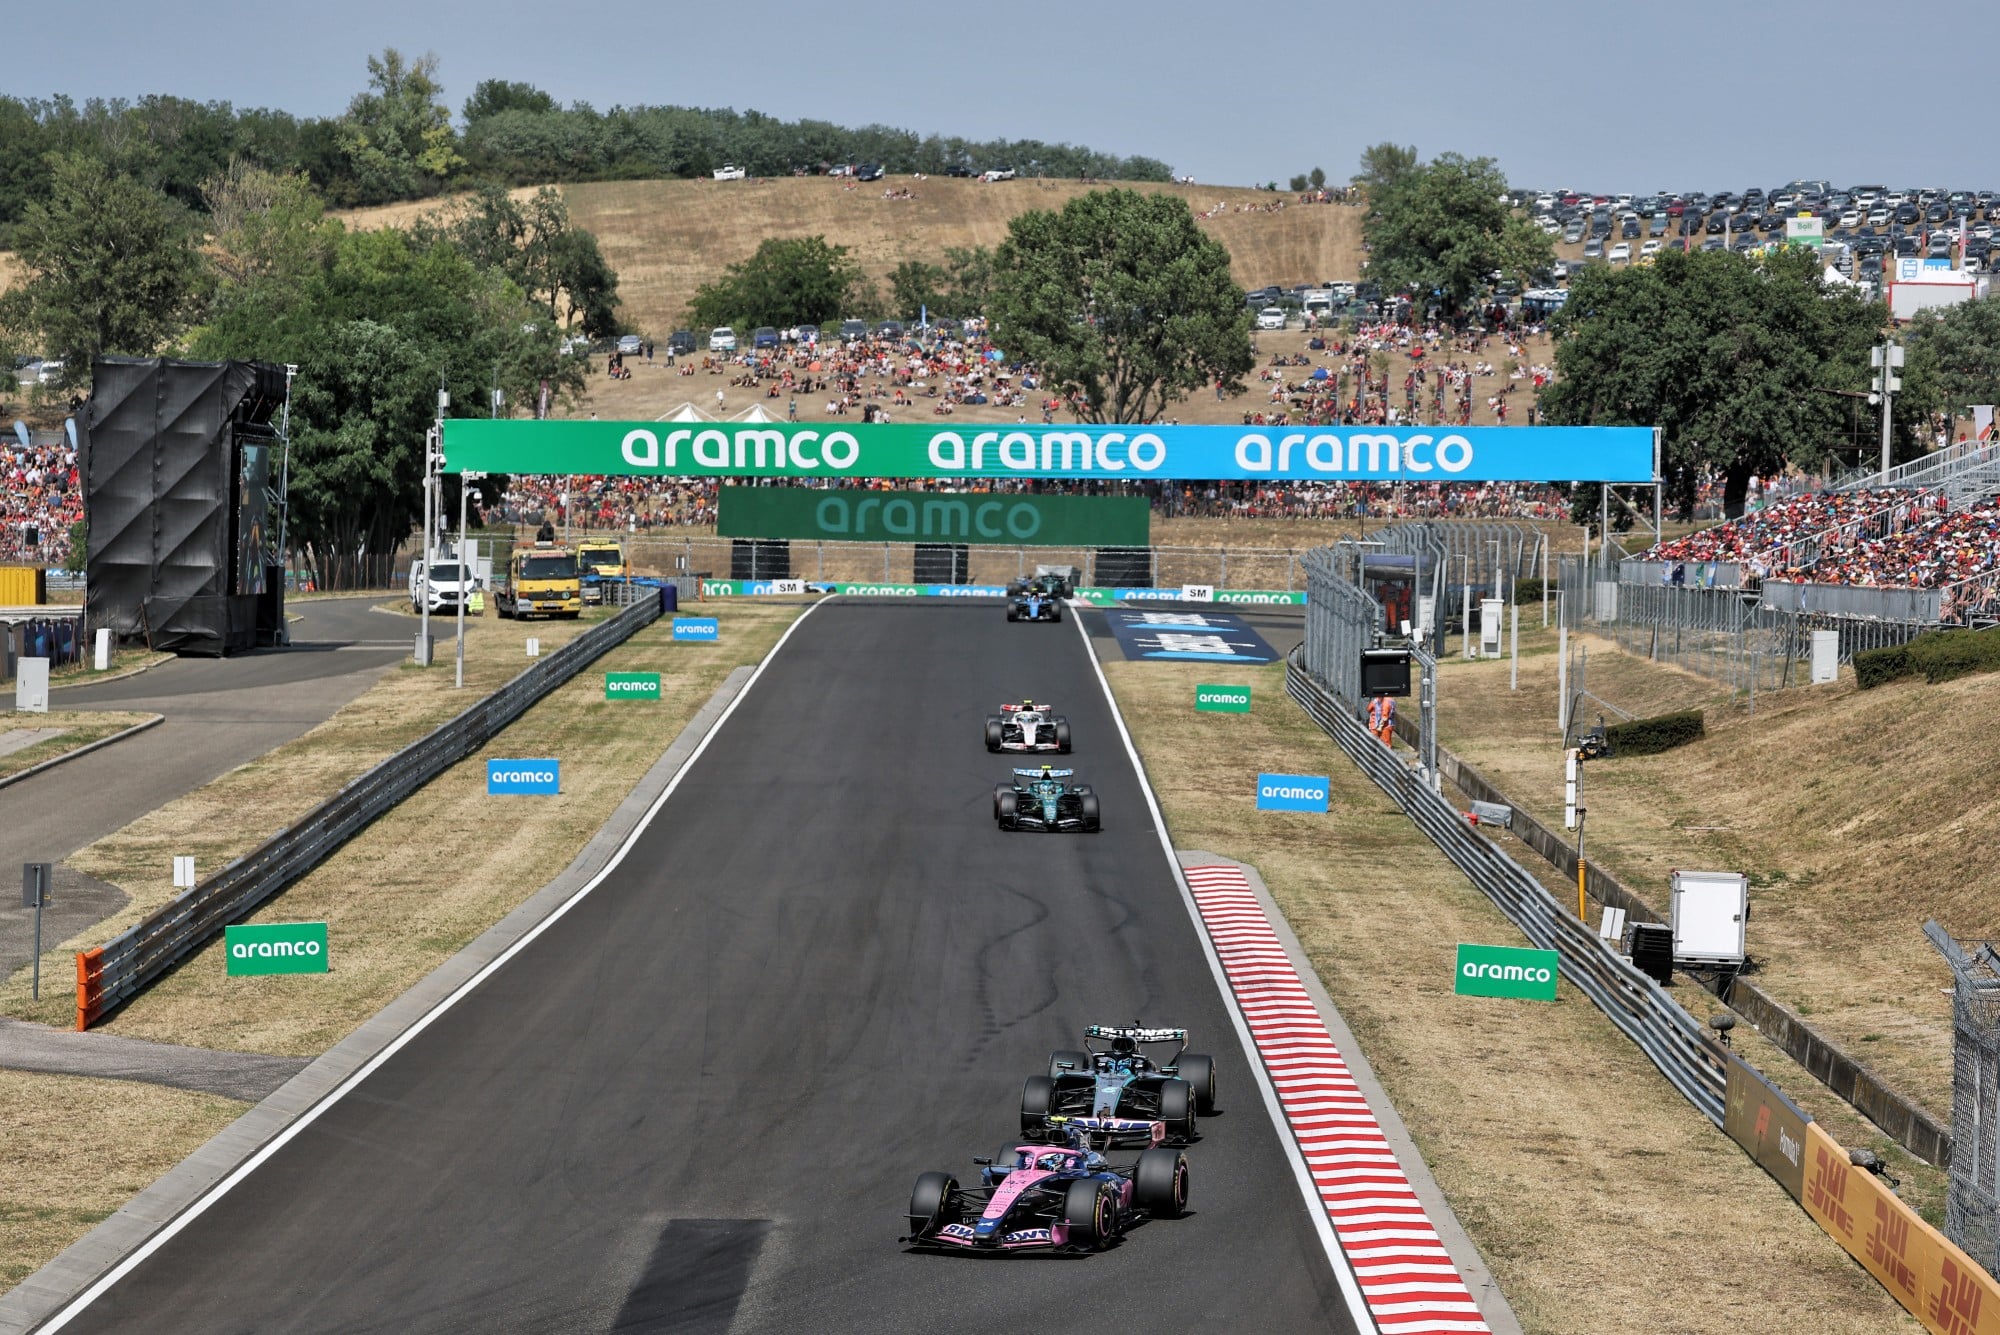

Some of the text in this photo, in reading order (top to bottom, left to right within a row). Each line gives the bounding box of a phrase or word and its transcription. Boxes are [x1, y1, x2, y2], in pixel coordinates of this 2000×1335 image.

[621, 430, 860, 469] aramco
[928, 432, 1167, 471] aramco
[1234, 434, 1474, 473] aramco
[815, 497, 1041, 539] aramco
[779, 583, 797, 592] SM
[1189, 588, 1207, 598] SM
[675, 625, 716, 634] aramco
[608, 681, 658, 691] aramco
[1198, 692, 1248, 705] aramco
[492, 769, 555, 784] aramco
[1261, 785, 1325, 801] aramco
[232, 940, 320, 959] aramco
[1462, 961, 1551, 984] aramco
[1811, 1145, 1849, 1233] DHL
[1872, 1197, 1910, 1290] DHL
